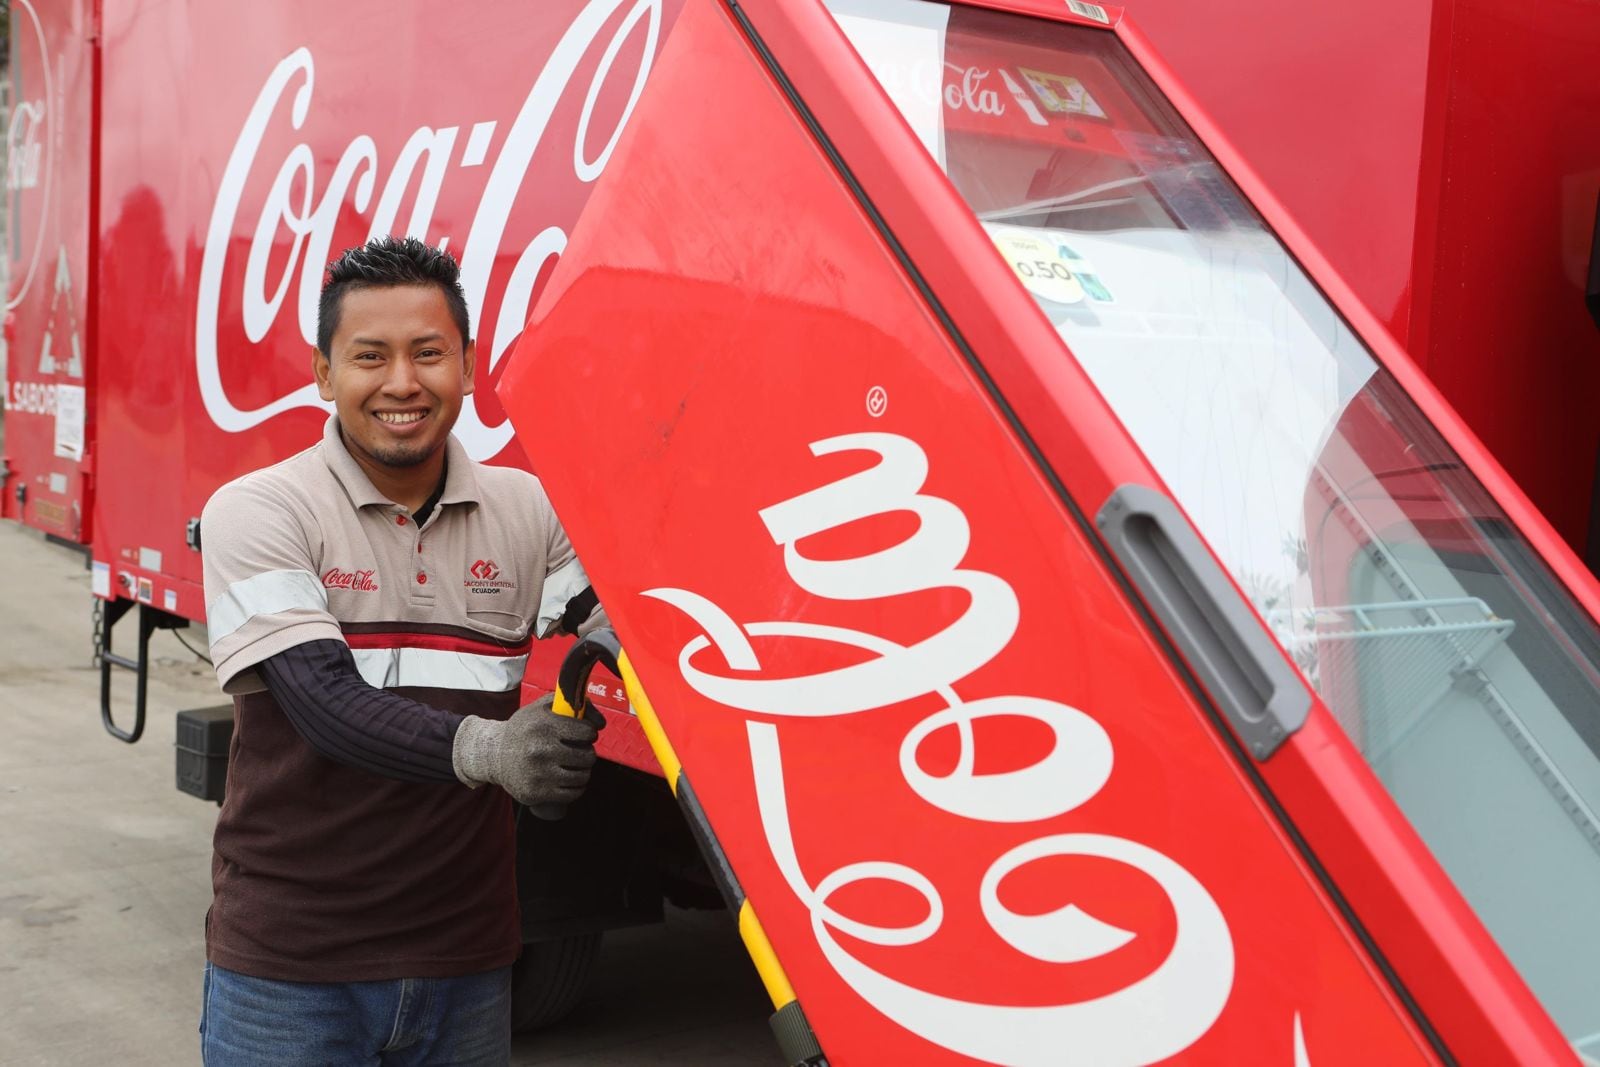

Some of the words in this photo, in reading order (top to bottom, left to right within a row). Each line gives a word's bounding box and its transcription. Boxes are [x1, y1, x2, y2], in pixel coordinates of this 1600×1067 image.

[196, 0, 663, 463] Coca-Co
[1016, 260, 1072, 280] 0.50
[321, 567, 378, 591] Coca-Cola
